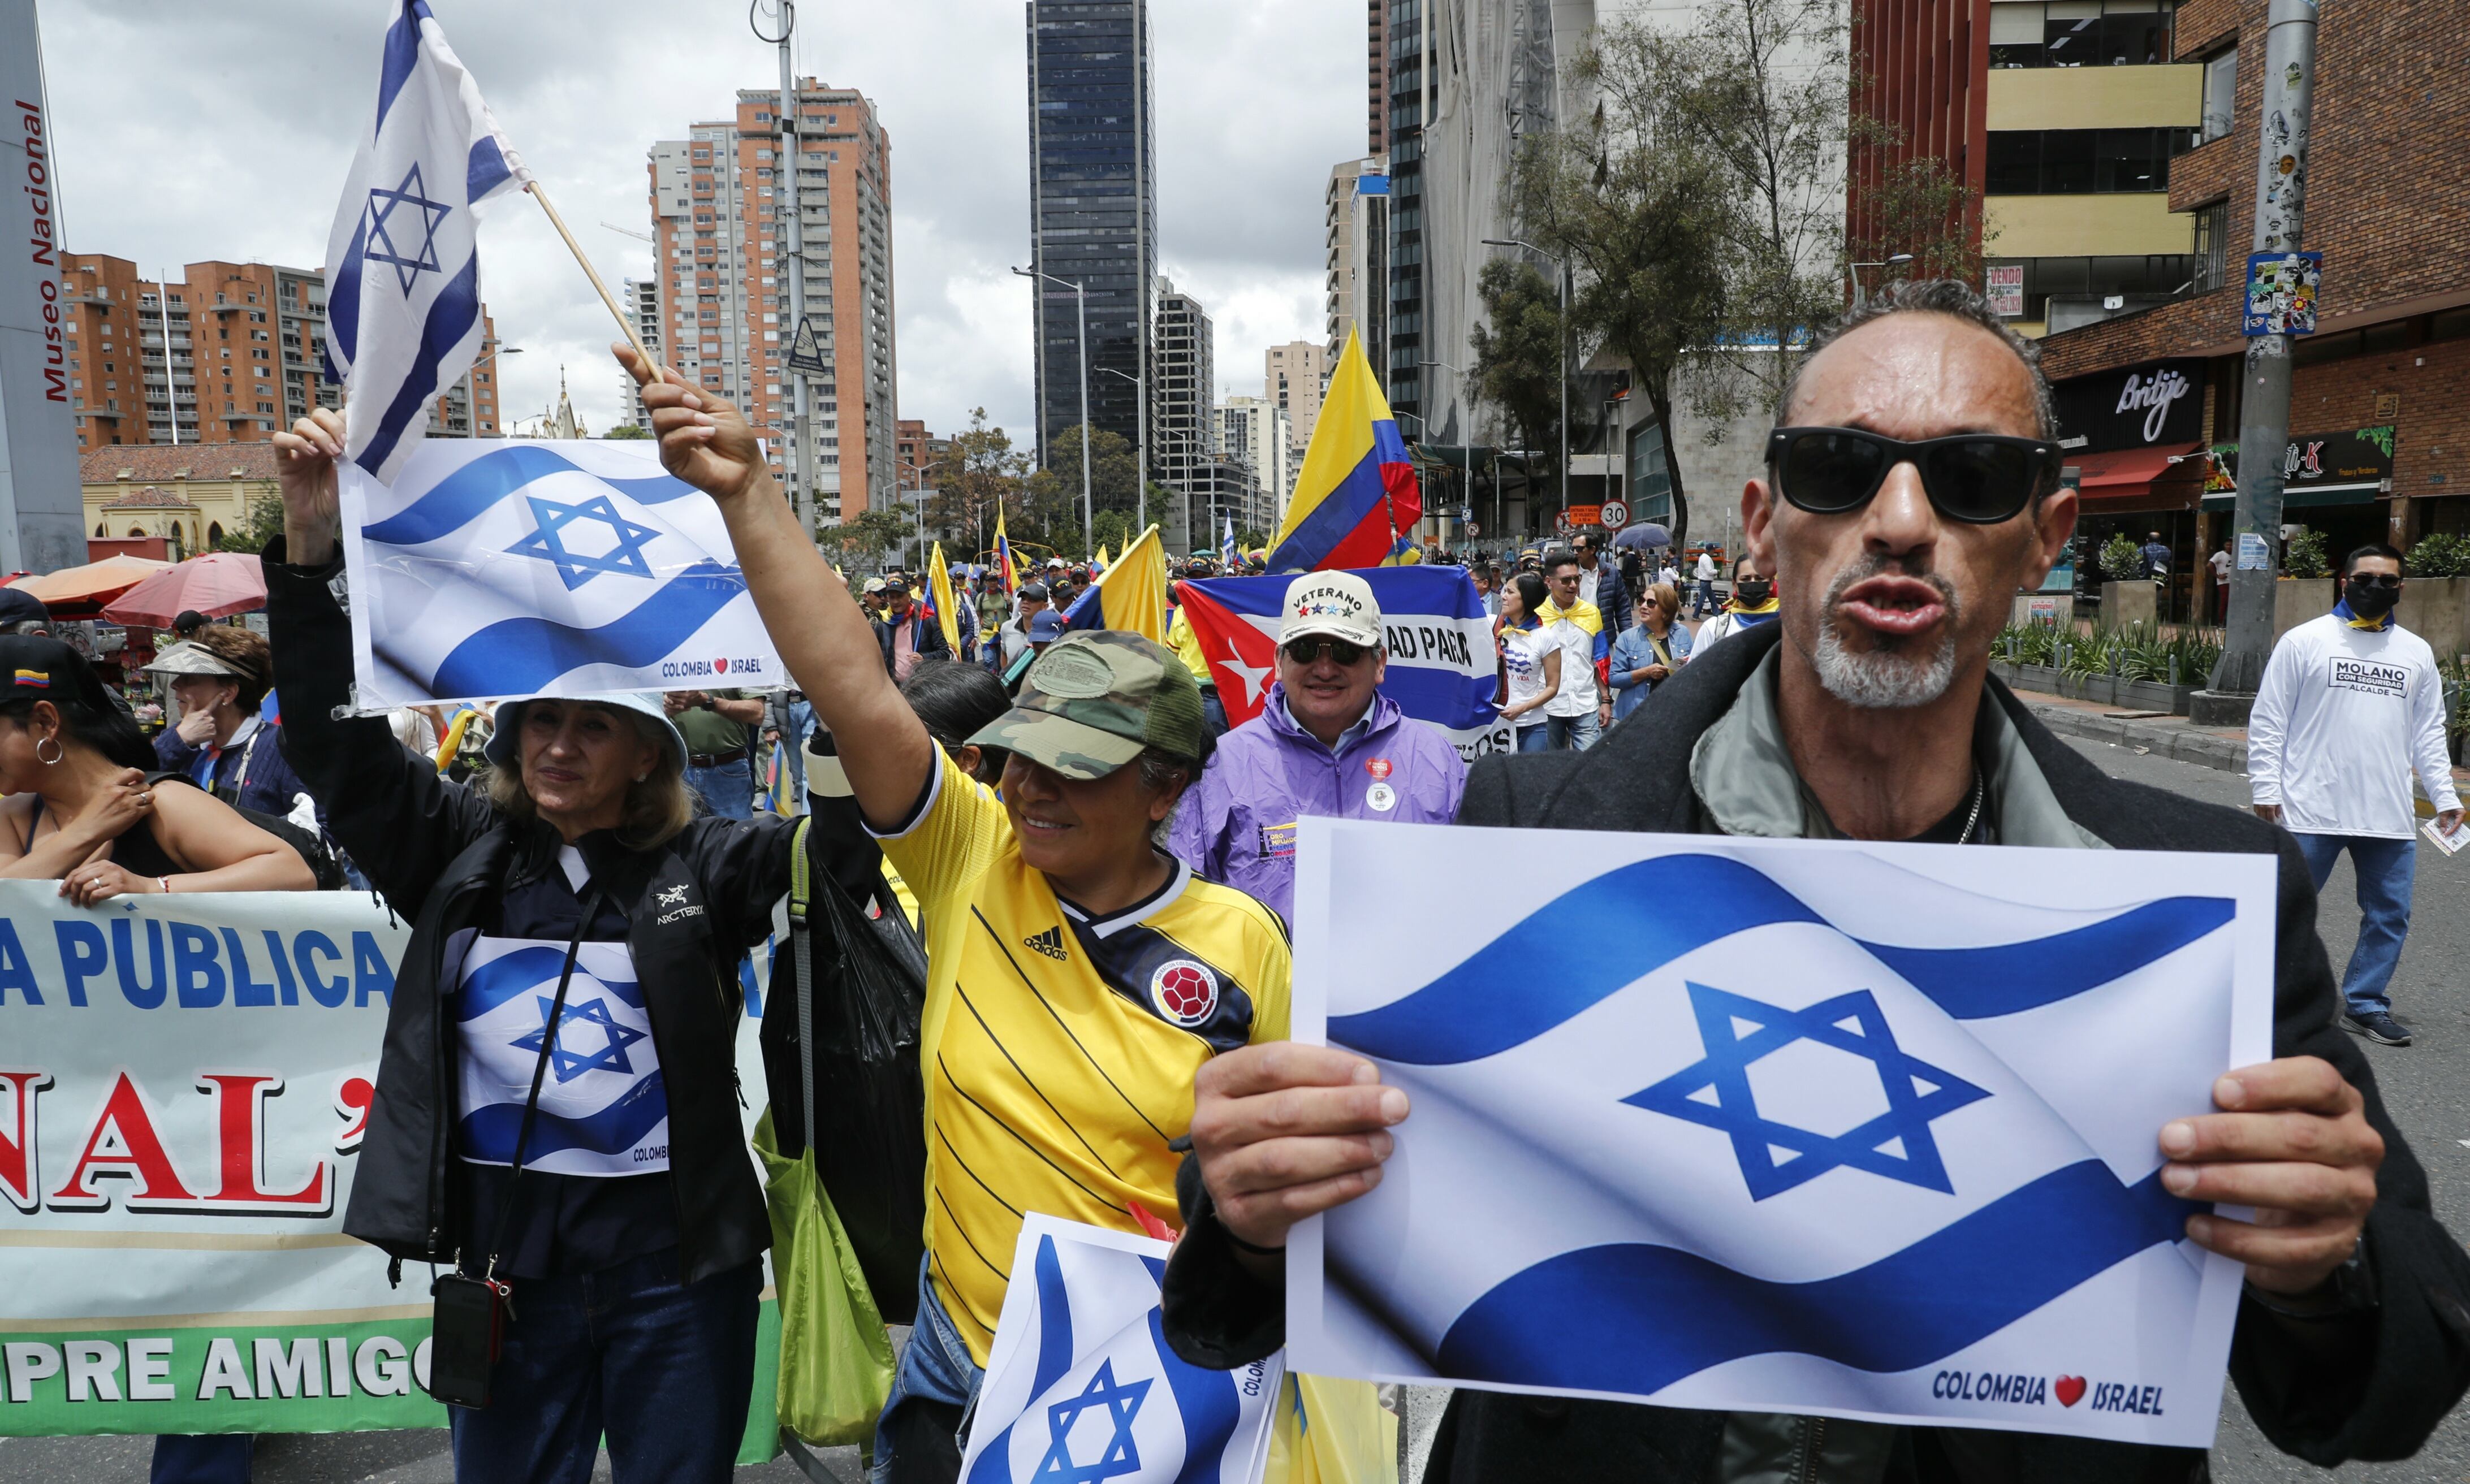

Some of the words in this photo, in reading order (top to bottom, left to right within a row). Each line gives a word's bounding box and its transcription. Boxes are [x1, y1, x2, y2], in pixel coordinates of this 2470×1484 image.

[15, 100, 54, 266] Nacional
[1990, 268, 2021, 284] VENDO
[41, 280, 67, 402] Museo
[1605, 508, 1623, 522] 30
[1293, 587, 1362, 611] VETERANO
[1419, 626, 1472, 668] PARA
[662, 660, 712, 678] COLOMBIA
[731, 658, 762, 674] ISRAEL
[2337, 662, 2405, 681] MOLANO
[2349, 684, 2390, 696] ALCALDE
[2357, 676, 2403, 689] SEGURIDAD
[1024, 937, 1068, 961] adidas
[0, 1338, 175, 1402] PRE
[1933, 1370, 2046, 1405] COLOMBIA
[2092, 1382, 2164, 1416] ISRAEL
